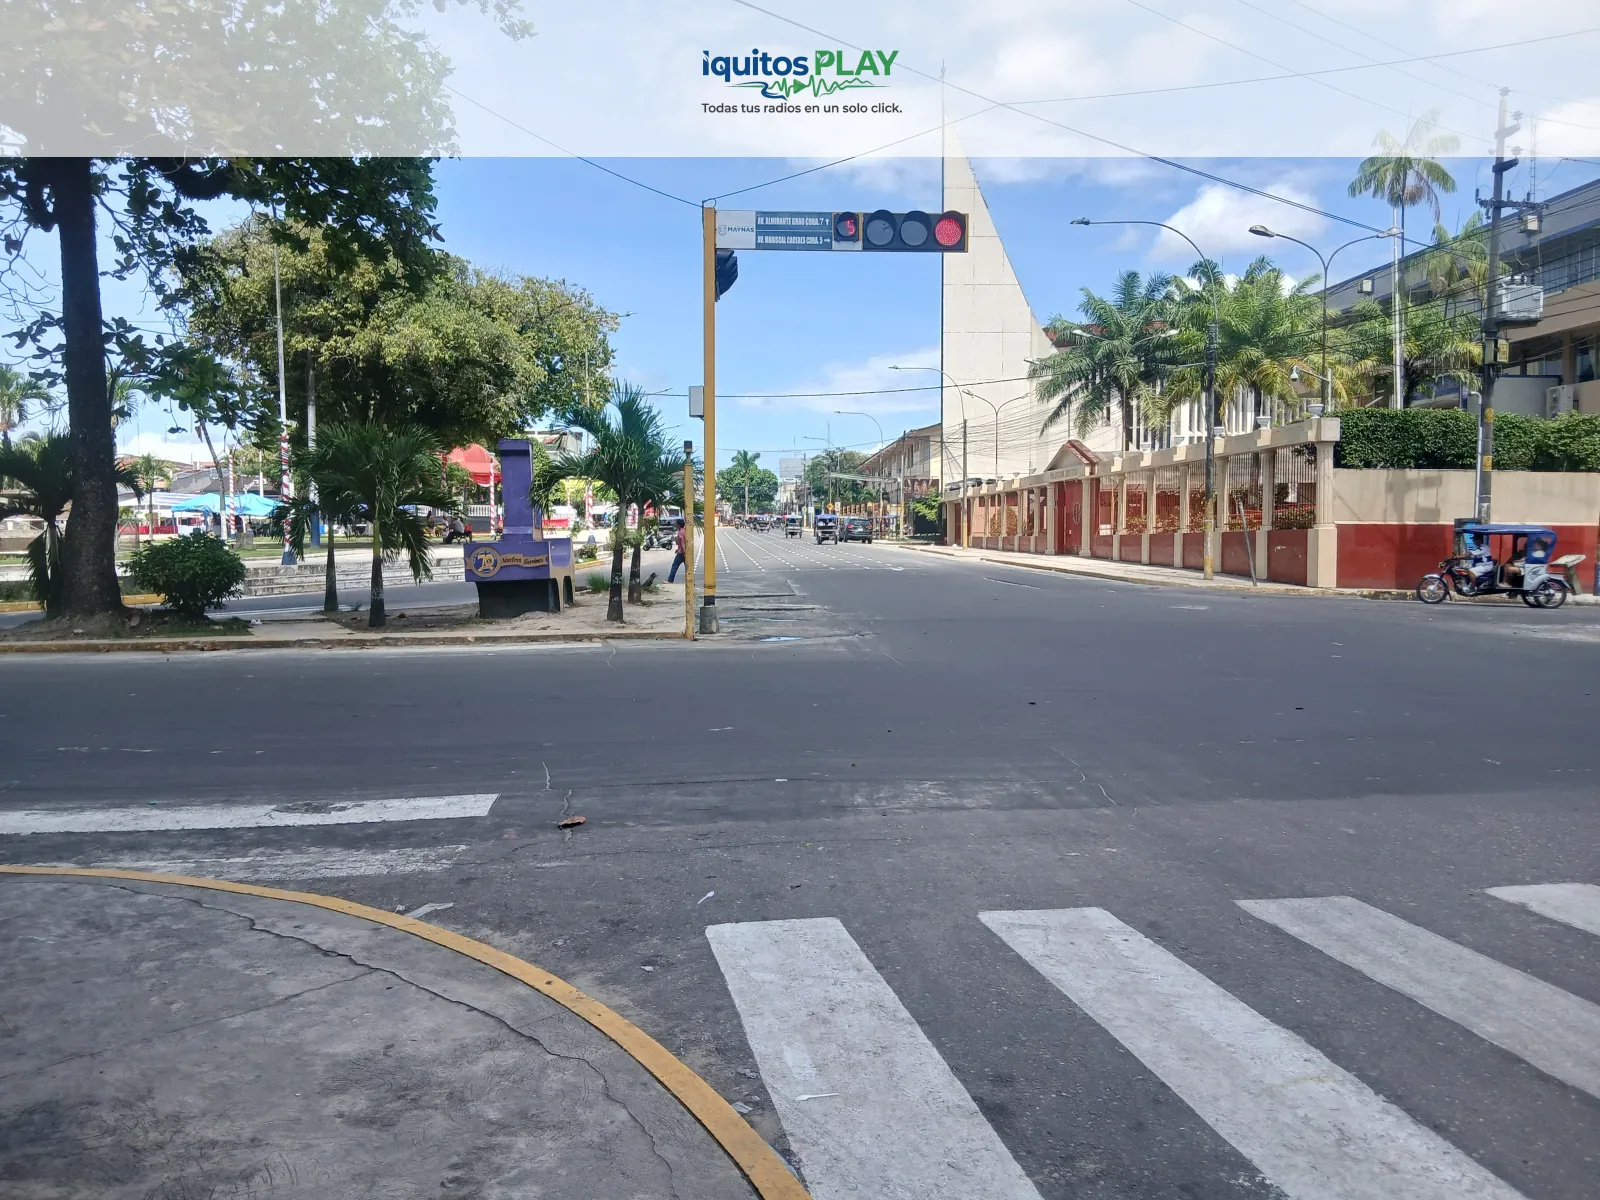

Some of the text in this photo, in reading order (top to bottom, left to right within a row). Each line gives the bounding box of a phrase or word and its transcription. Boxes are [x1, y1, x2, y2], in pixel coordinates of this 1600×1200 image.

[765, 217, 791, 225] ALMIRANTE
[819, 218, 824, 226] 7
[765, 236, 786, 244] MARISCAL
[819, 236, 823, 245] 5
